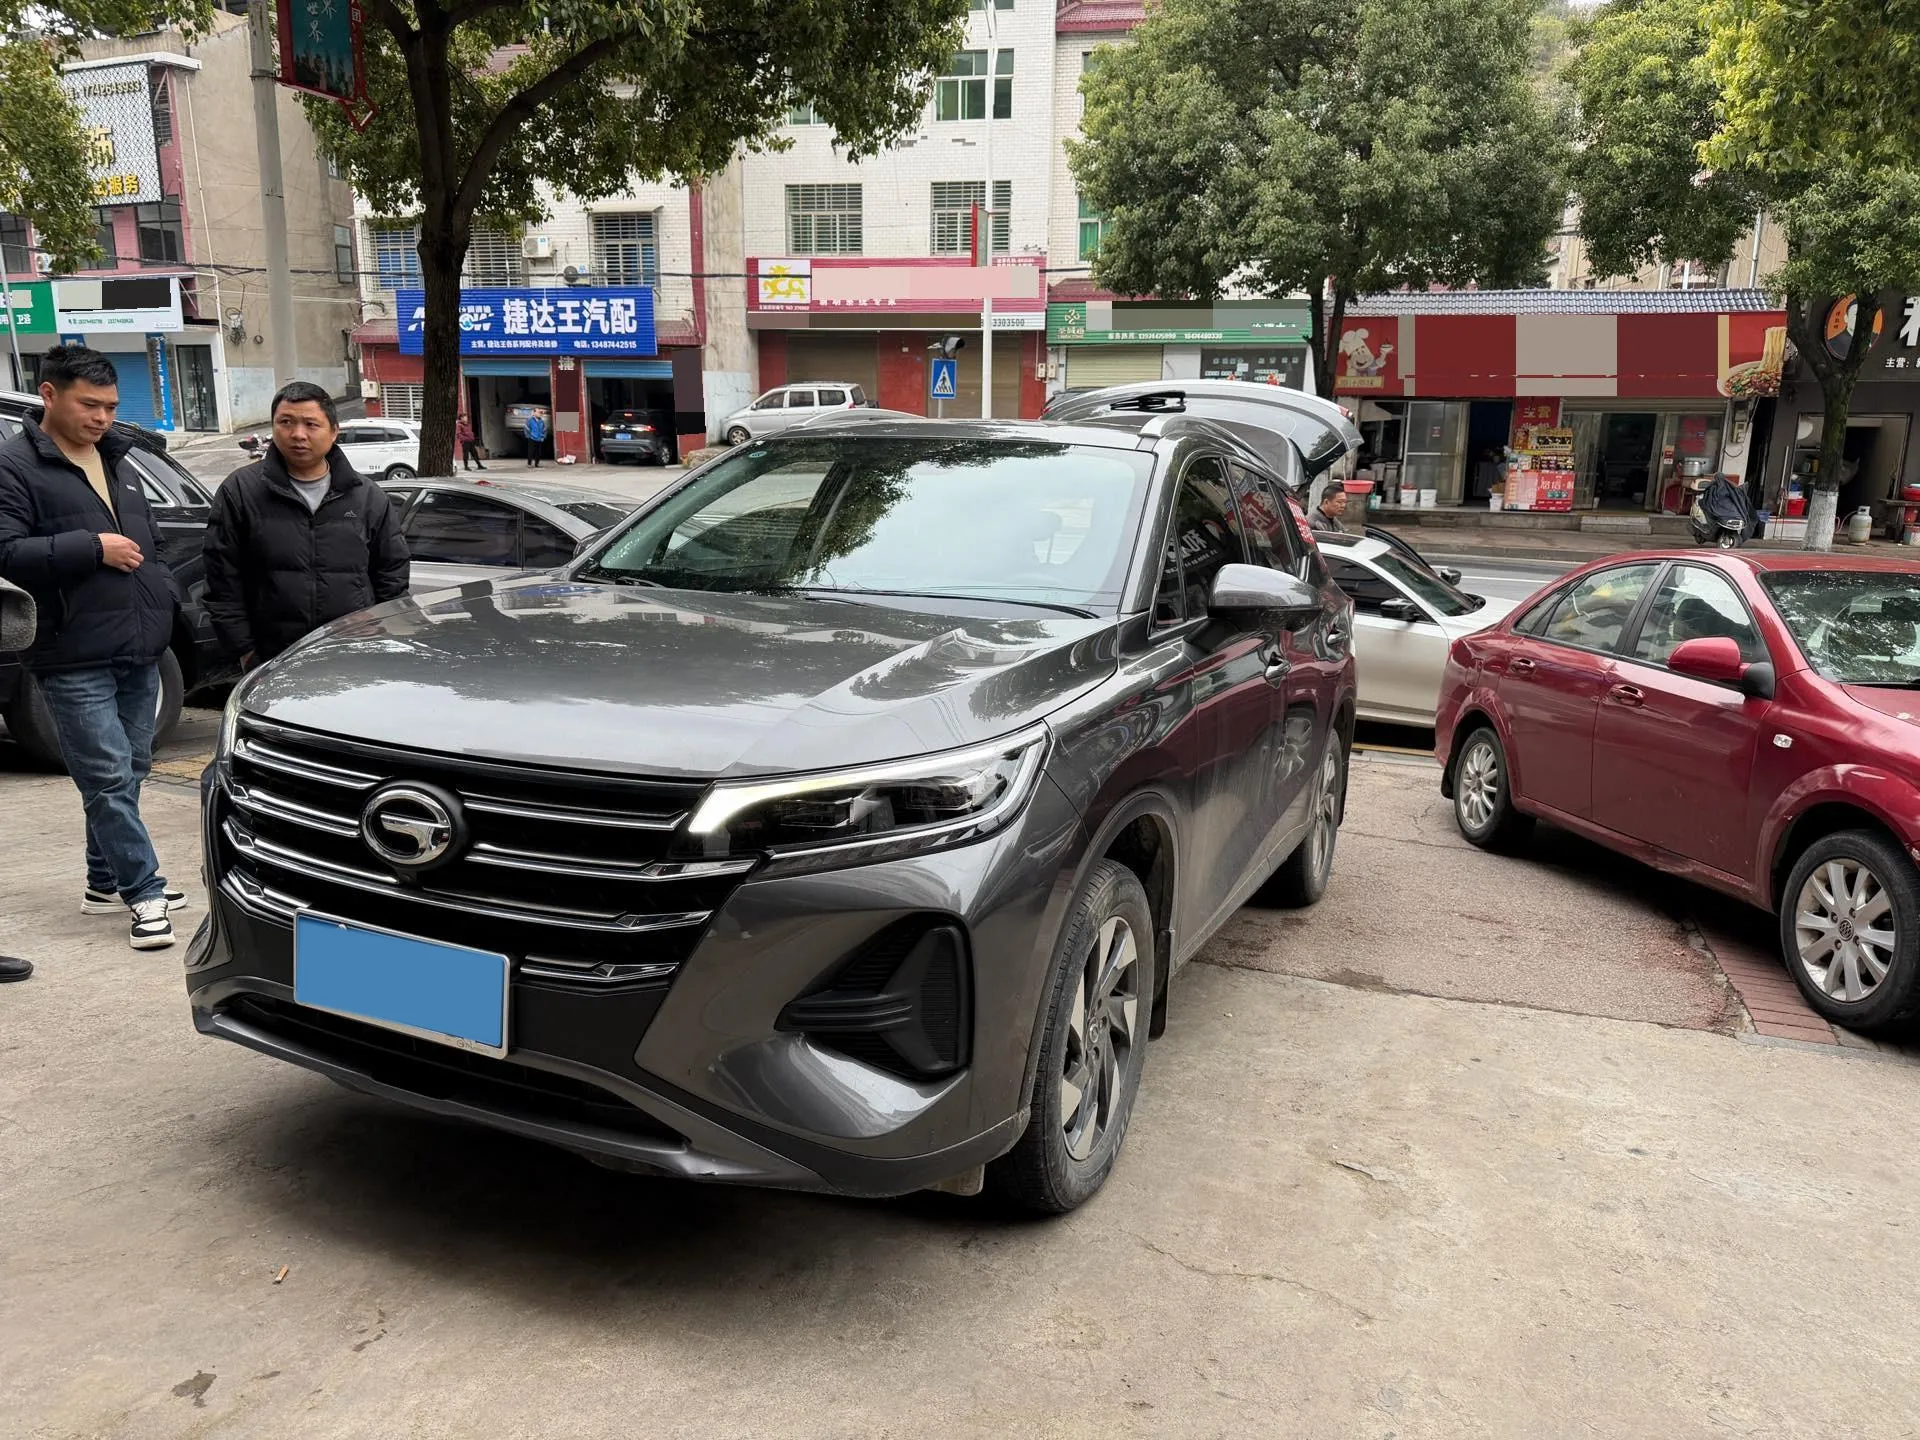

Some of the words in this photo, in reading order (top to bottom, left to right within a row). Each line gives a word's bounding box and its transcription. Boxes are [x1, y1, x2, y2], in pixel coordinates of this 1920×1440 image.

[503, 298, 638, 335] 捷达王汽配
